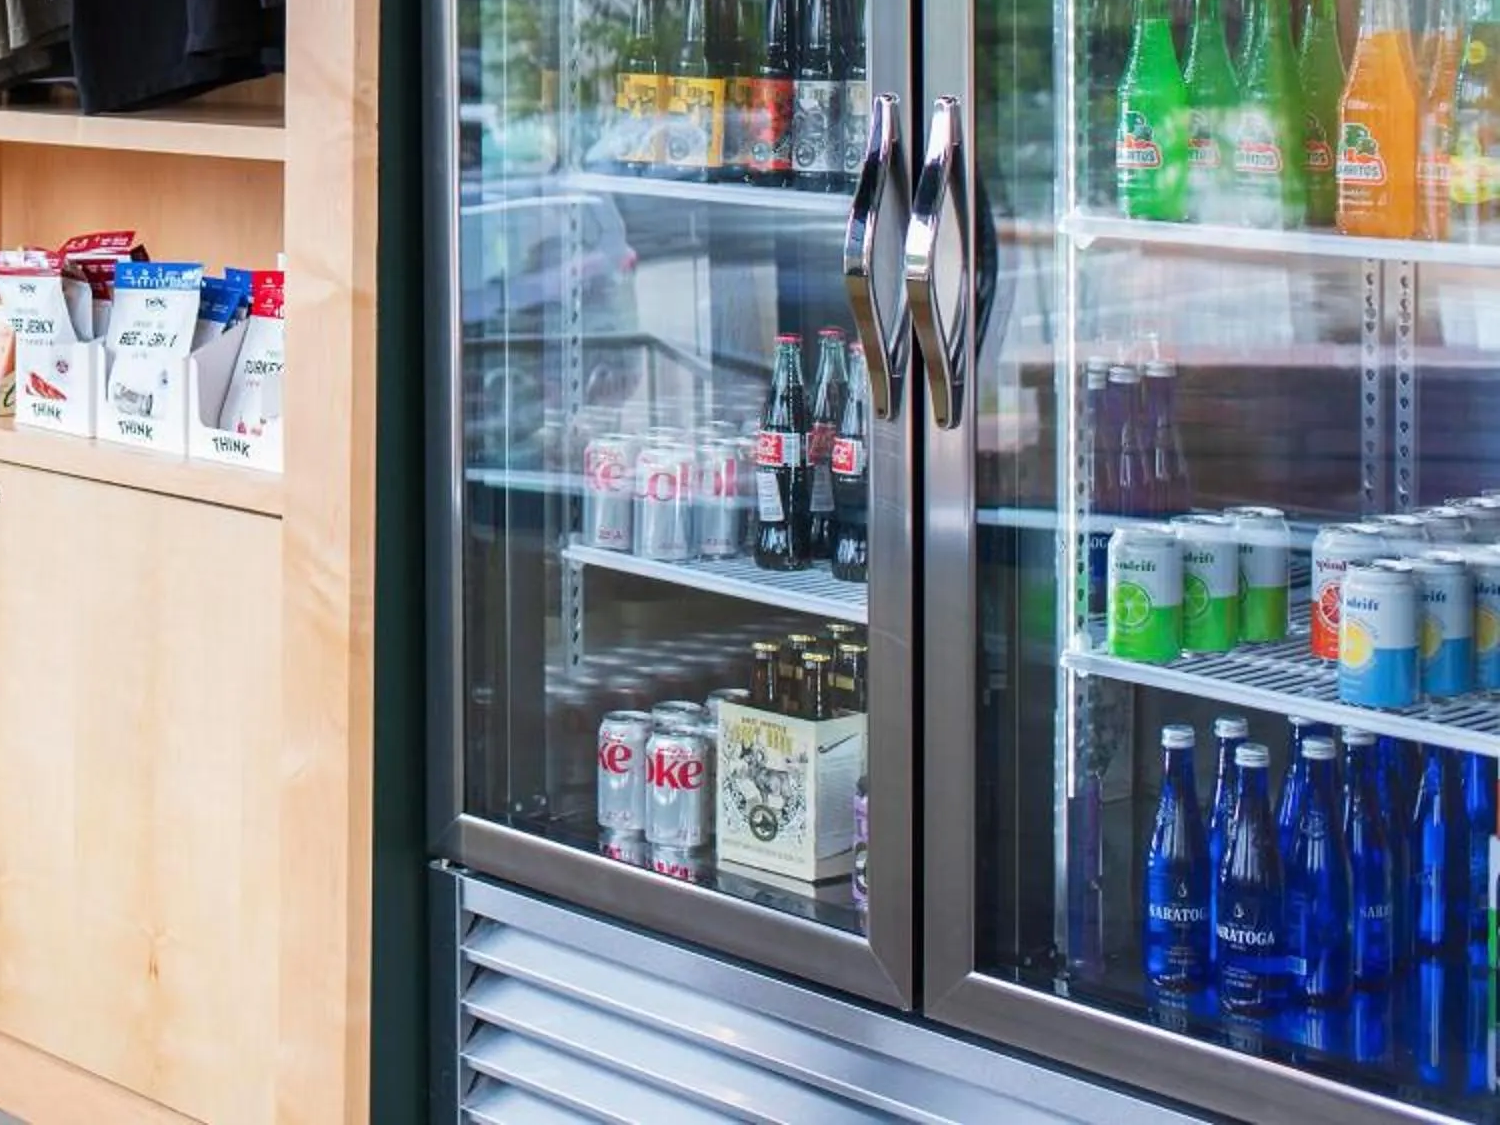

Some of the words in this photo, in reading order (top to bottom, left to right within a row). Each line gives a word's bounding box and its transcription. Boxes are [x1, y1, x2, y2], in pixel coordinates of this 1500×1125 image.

[31, 402, 61, 423] THINK
[118, 420, 153, 440] THINK
[212, 436, 250, 459] THINK
